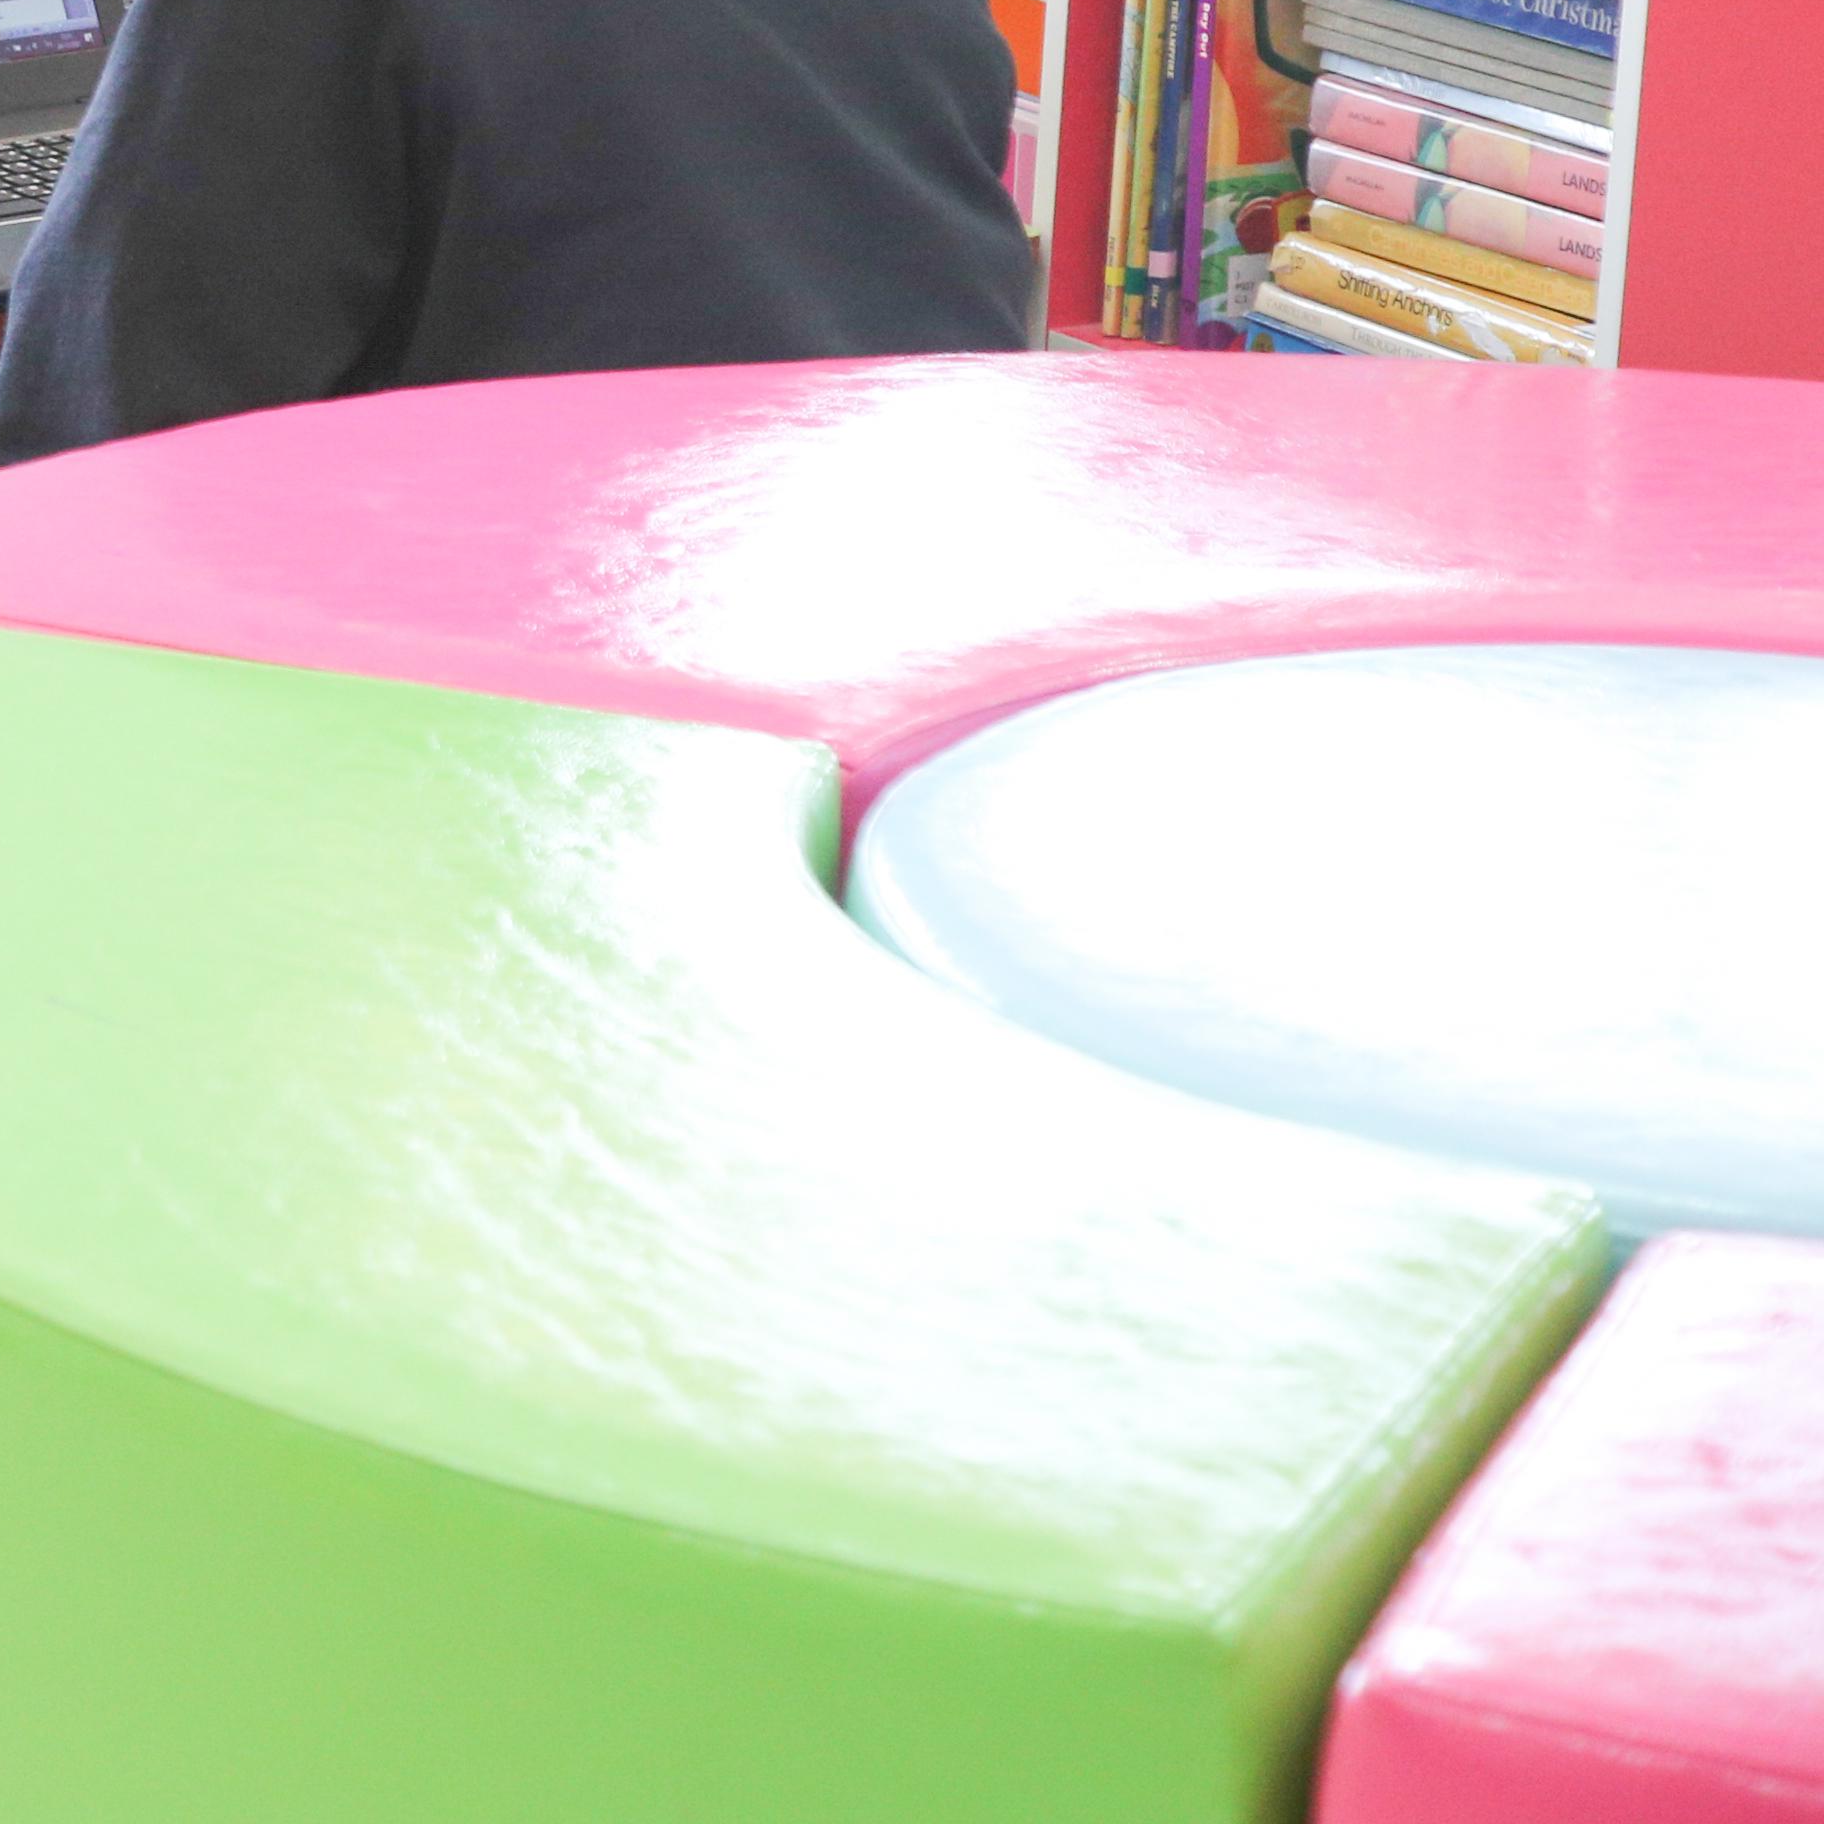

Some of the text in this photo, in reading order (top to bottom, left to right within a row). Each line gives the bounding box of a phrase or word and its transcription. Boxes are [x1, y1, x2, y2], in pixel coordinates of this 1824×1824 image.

[1199, 2, 1211, 29] Day
[1199, 31, 1210, 59] Out
[1337, 270, 1454, 328] Shifting Anchors
